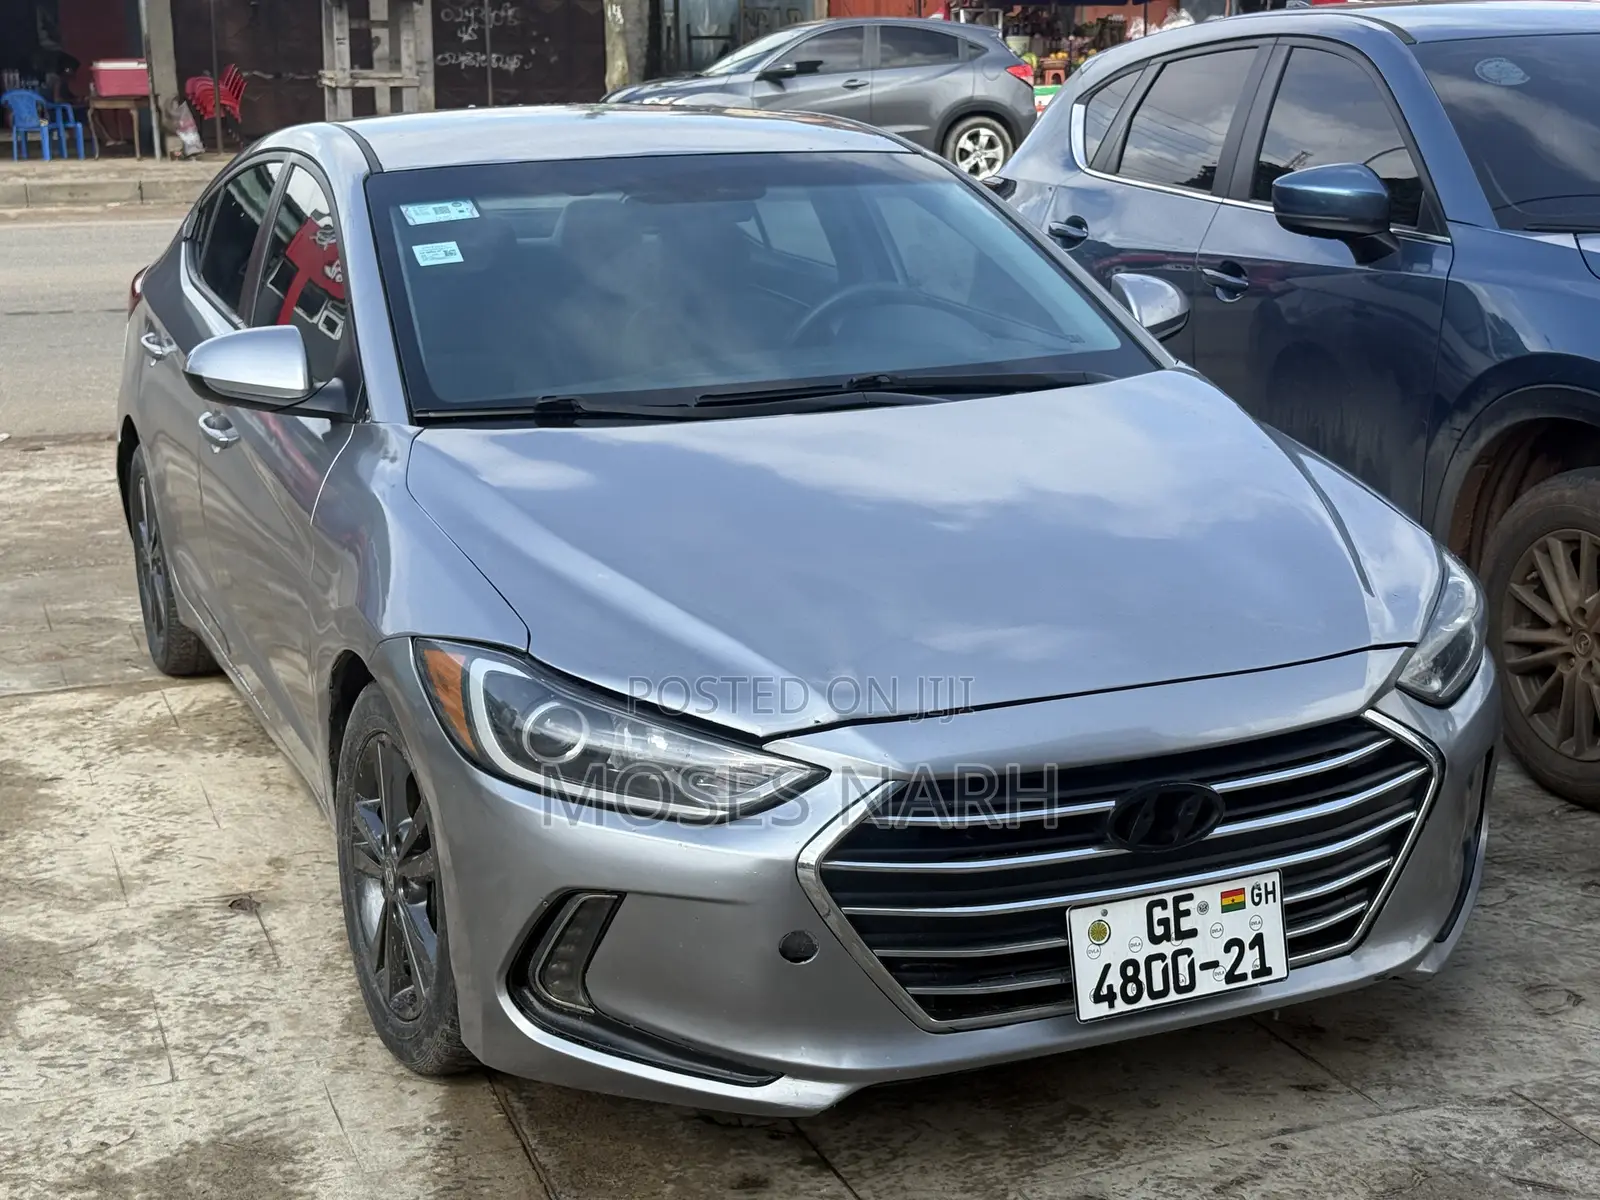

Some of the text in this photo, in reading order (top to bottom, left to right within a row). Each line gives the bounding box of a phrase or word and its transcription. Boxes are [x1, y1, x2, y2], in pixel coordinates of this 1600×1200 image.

[1146, 881, 1276, 945] GE GH
[1093, 932, 1272, 1008] 4800-21
